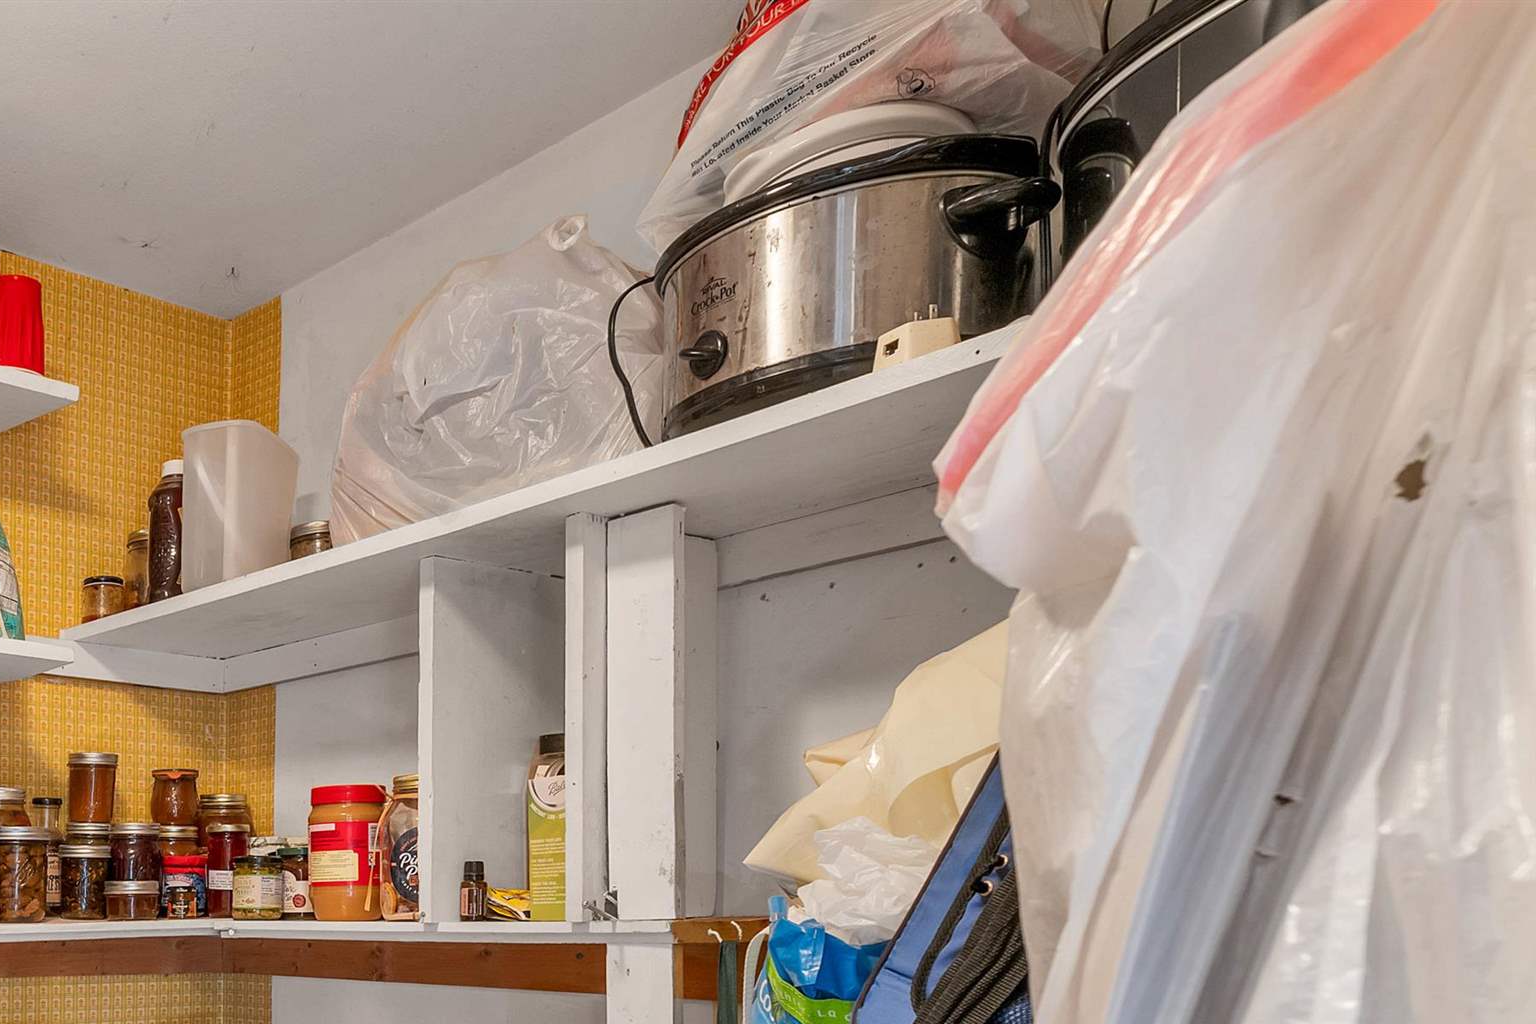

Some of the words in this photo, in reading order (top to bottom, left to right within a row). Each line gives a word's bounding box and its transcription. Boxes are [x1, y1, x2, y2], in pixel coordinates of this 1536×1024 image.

[703, 142, 736, 169] Located
[736, 126, 762, 145] Inside
[815, 67, 848, 90] Basket
[736, 116, 754, 131] This
[755, 95, 785, 117] Plastic
[838, 33, 877, 64] Recycle
